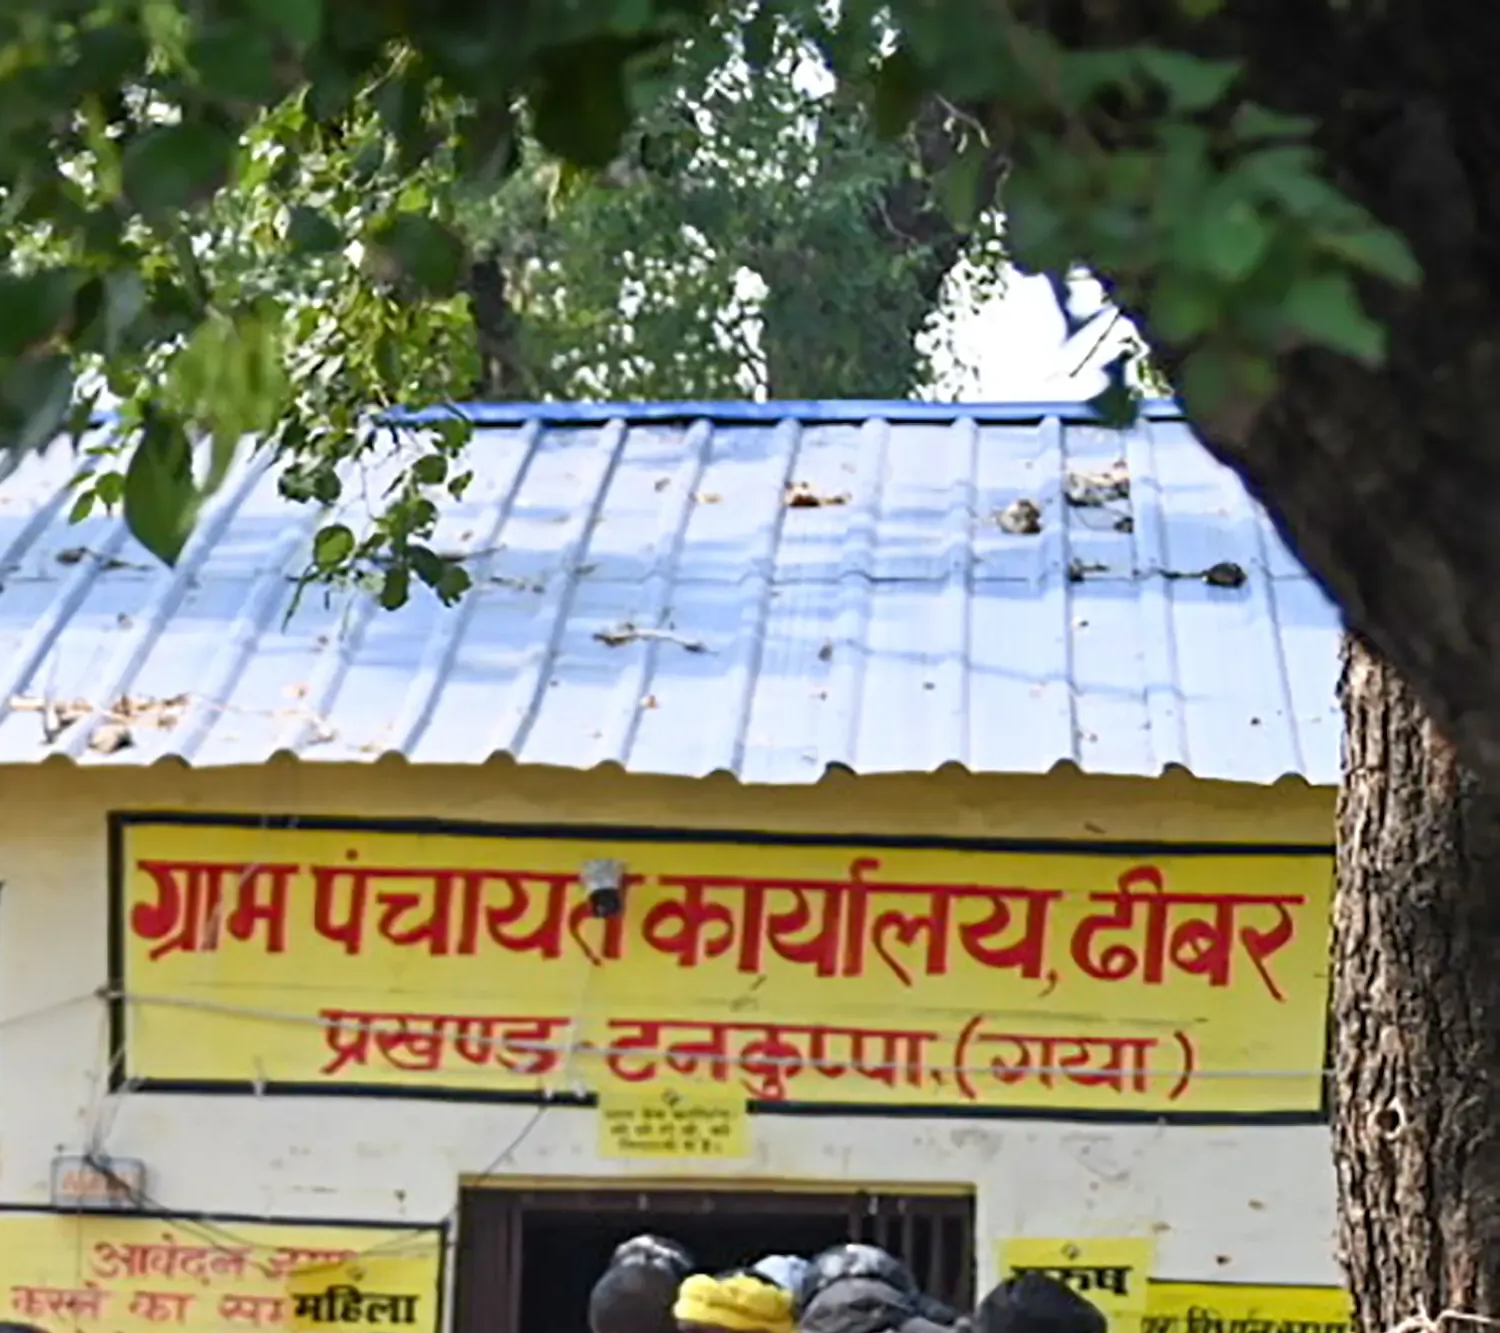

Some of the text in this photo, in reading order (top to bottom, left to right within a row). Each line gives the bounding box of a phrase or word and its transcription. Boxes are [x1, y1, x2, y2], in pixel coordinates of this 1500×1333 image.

[130, 860, 299, 961] ग्राम
[311, 848, 643, 966] पंचायत
[1070, 865, 1307, 1003] ढीबर
[319, 1008, 571, 1074] प्रखण्ड
[293, 1281, 418, 1324] महिला
